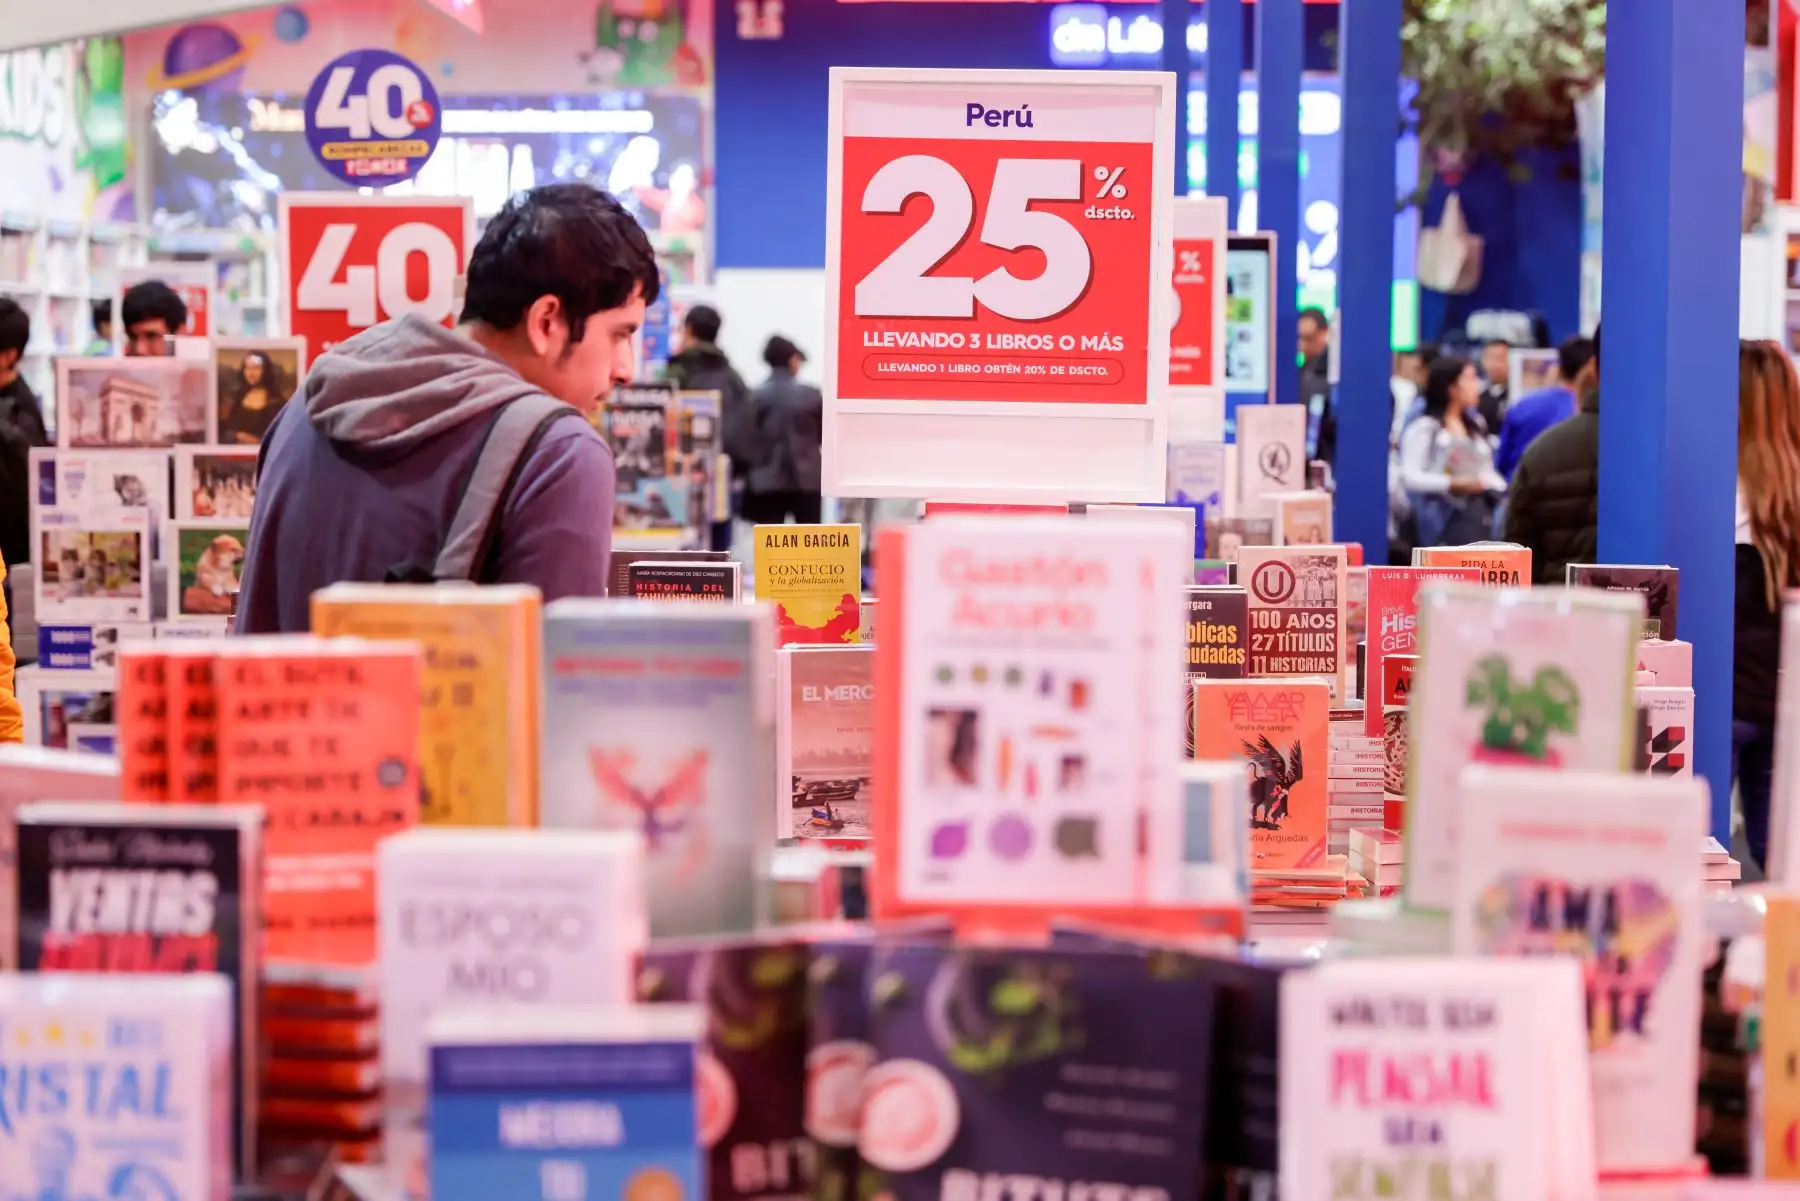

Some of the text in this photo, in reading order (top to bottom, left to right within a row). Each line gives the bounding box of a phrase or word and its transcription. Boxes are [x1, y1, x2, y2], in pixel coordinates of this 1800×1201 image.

[315, 64, 424, 139] 40
[966, 102, 1034, 128] Perú
[1094, 166, 1127, 199] %
[1084, 205, 1136, 220] dscto.
[854, 154, 1094, 321] 25
[297, 221, 459, 328] 40
[863, 331, 1124, 351] LLEVANDO 3 LIBROS O MÁS
[877, 361, 1109, 376] LLEVANDO 1 LIBRO OBTÉN 20% DE DSCTO.
[765, 531, 850, 548] ALAN GARCÍA
[768, 564, 845, 576] CONFUCIO
[1491, 559, 1505, 569] LA
[636, 583, 725, 592] HISTORIA DEL
[777, 575, 786, 585] la
[788, 575, 845, 587] globalización
[1182, 600, 1213, 611] ergara
[1251, 610, 1336, 630] 100 AÑOS
[1379, 612, 1417, 636] His
[1184, 620, 1238, 645] blicas
[1252, 631, 1335, 652] 27 TÍTULOS
[1381, 631, 1418, 652] GEN
[1640, 630, 1660, 639] ción
[1183, 644, 1246, 665] audadas
[1252, 656, 1335, 674] 11 HISTORIAS
[802, 683, 876, 702] EL MERC
[1230, 706, 1301, 723] FIESTA
[1257, 723, 1265, 731] de
[1265, 833, 1309, 844] Arguedas
